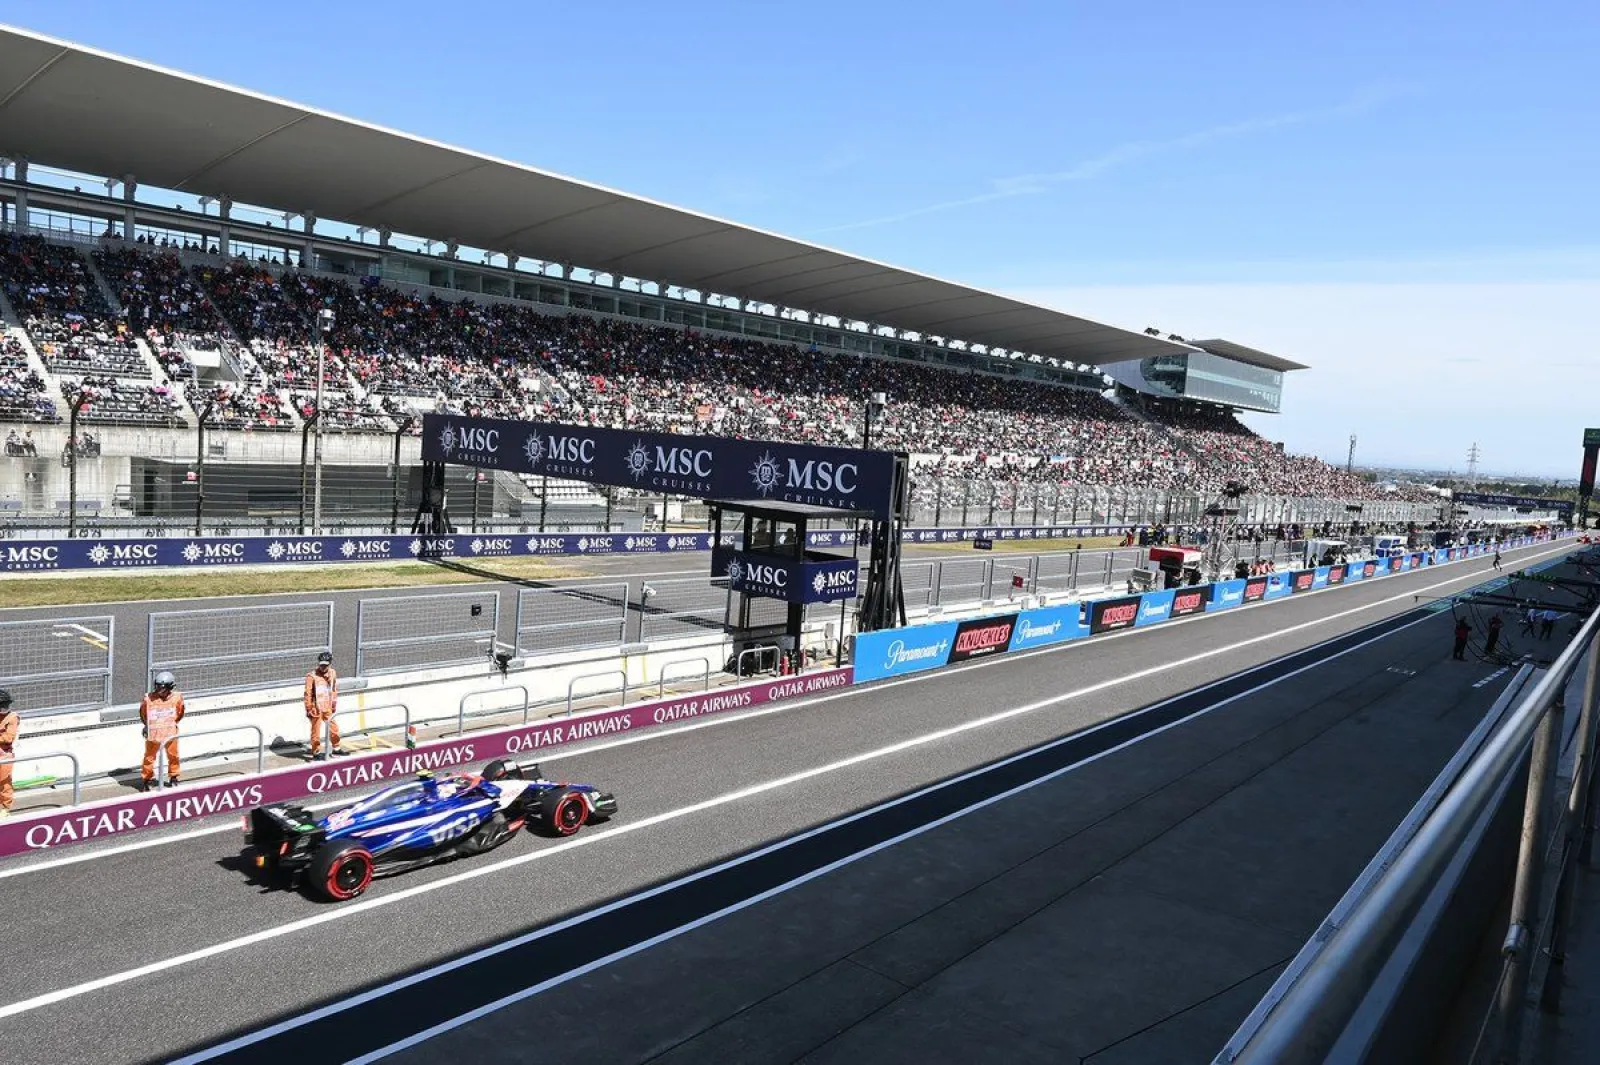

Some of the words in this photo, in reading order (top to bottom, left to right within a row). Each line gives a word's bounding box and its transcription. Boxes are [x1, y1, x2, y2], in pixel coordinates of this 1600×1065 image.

[459, 428, 499, 452] MSC
[547, 436, 595, 464] MSC
[458, 454, 498, 464] CRUISES
[654, 446, 712, 477] MSC
[546, 464, 594, 477] CRUISES
[786, 458, 858, 494] MSC
[652, 476, 711, 491] CRUISES
[287, 541, 322, 555] MSC
[358, 540, 390, 553] MSC
[425, 539, 454, 551] MSC
[484, 539, 512, 550] MSC
[540, 538, 564, 548] MSC
[589, 538, 612, 548] MSC
[636, 537, 657, 547] MSC
[677, 536, 697, 546] MSC
[7, 546, 58, 562] MSC
[112, 544, 157, 559] MSC
[204, 543, 244, 557] MSC
[746, 563, 788, 587] MSC
[827, 570, 856, 587] MSC
[956, 624, 1010, 652] KNUCKLES
[884, 639, 948, 669] Paramount+
[768, 681, 805, 700] QATAR
[805, 673, 846, 692] AIRWAYS
[654, 700, 698, 723] QATAR
[700, 692, 751, 714] AIRWAYS
[506, 727, 563, 754] QATAR
[567, 714, 632, 741] AIRWAYS
[306, 761, 384, 793] QATAR
[389, 744, 475, 777] AIRWAYS
[25, 808, 137, 849] QATAR
[143, 784, 263, 826] AIRWAYS
